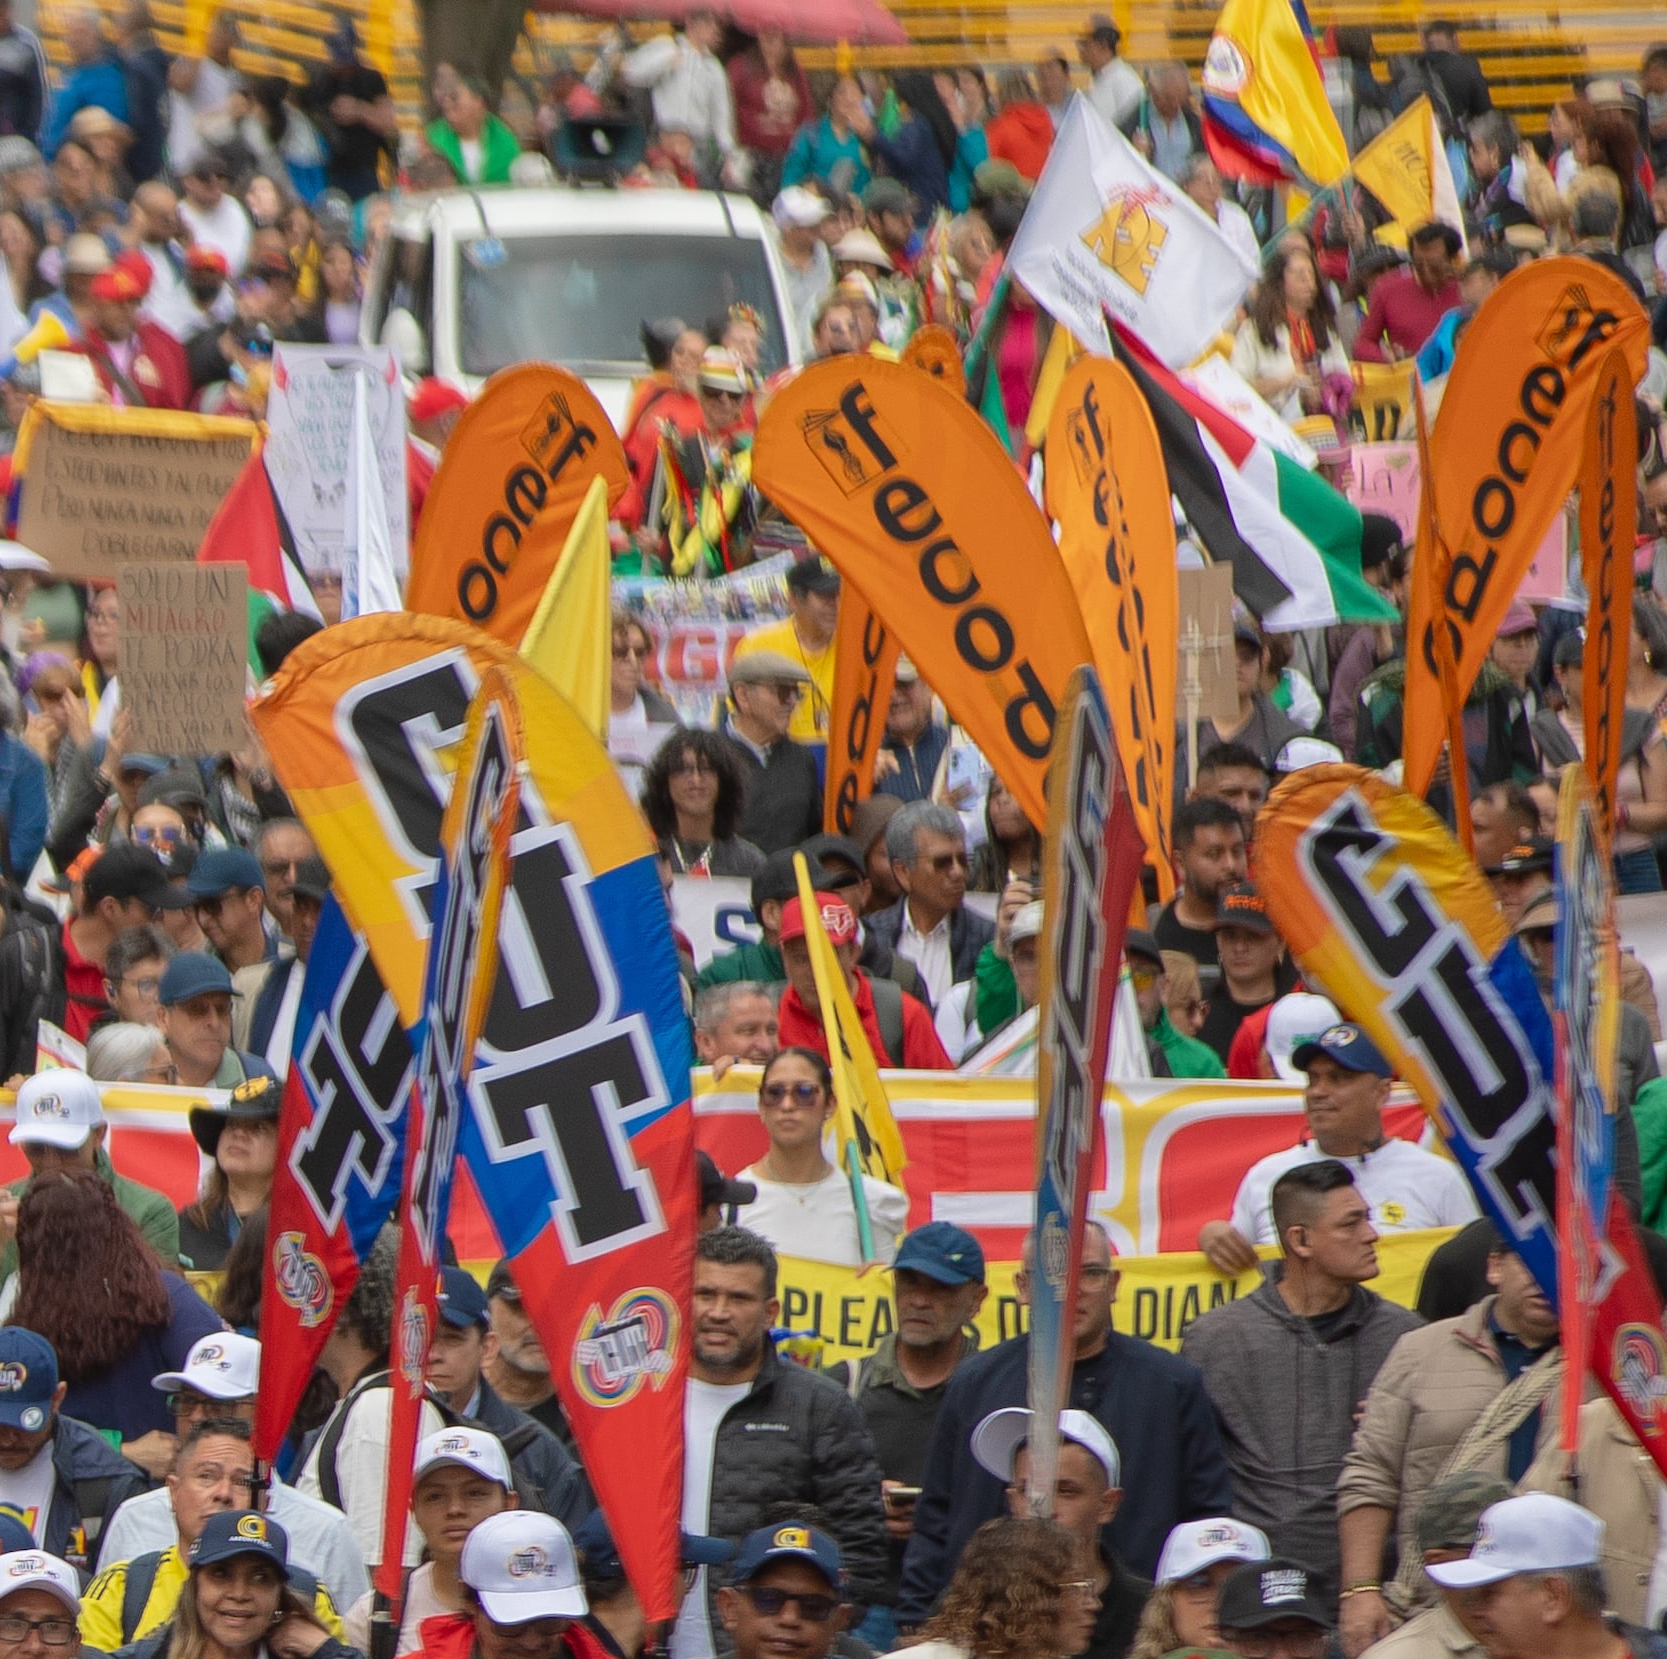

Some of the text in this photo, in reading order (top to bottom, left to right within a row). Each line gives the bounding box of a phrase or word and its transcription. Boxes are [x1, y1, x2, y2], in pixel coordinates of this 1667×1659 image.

[457, 420, 597, 623] feco
[122, 566, 229, 606] SOLO UN
[126, 603, 226, 633] MILAGRO
